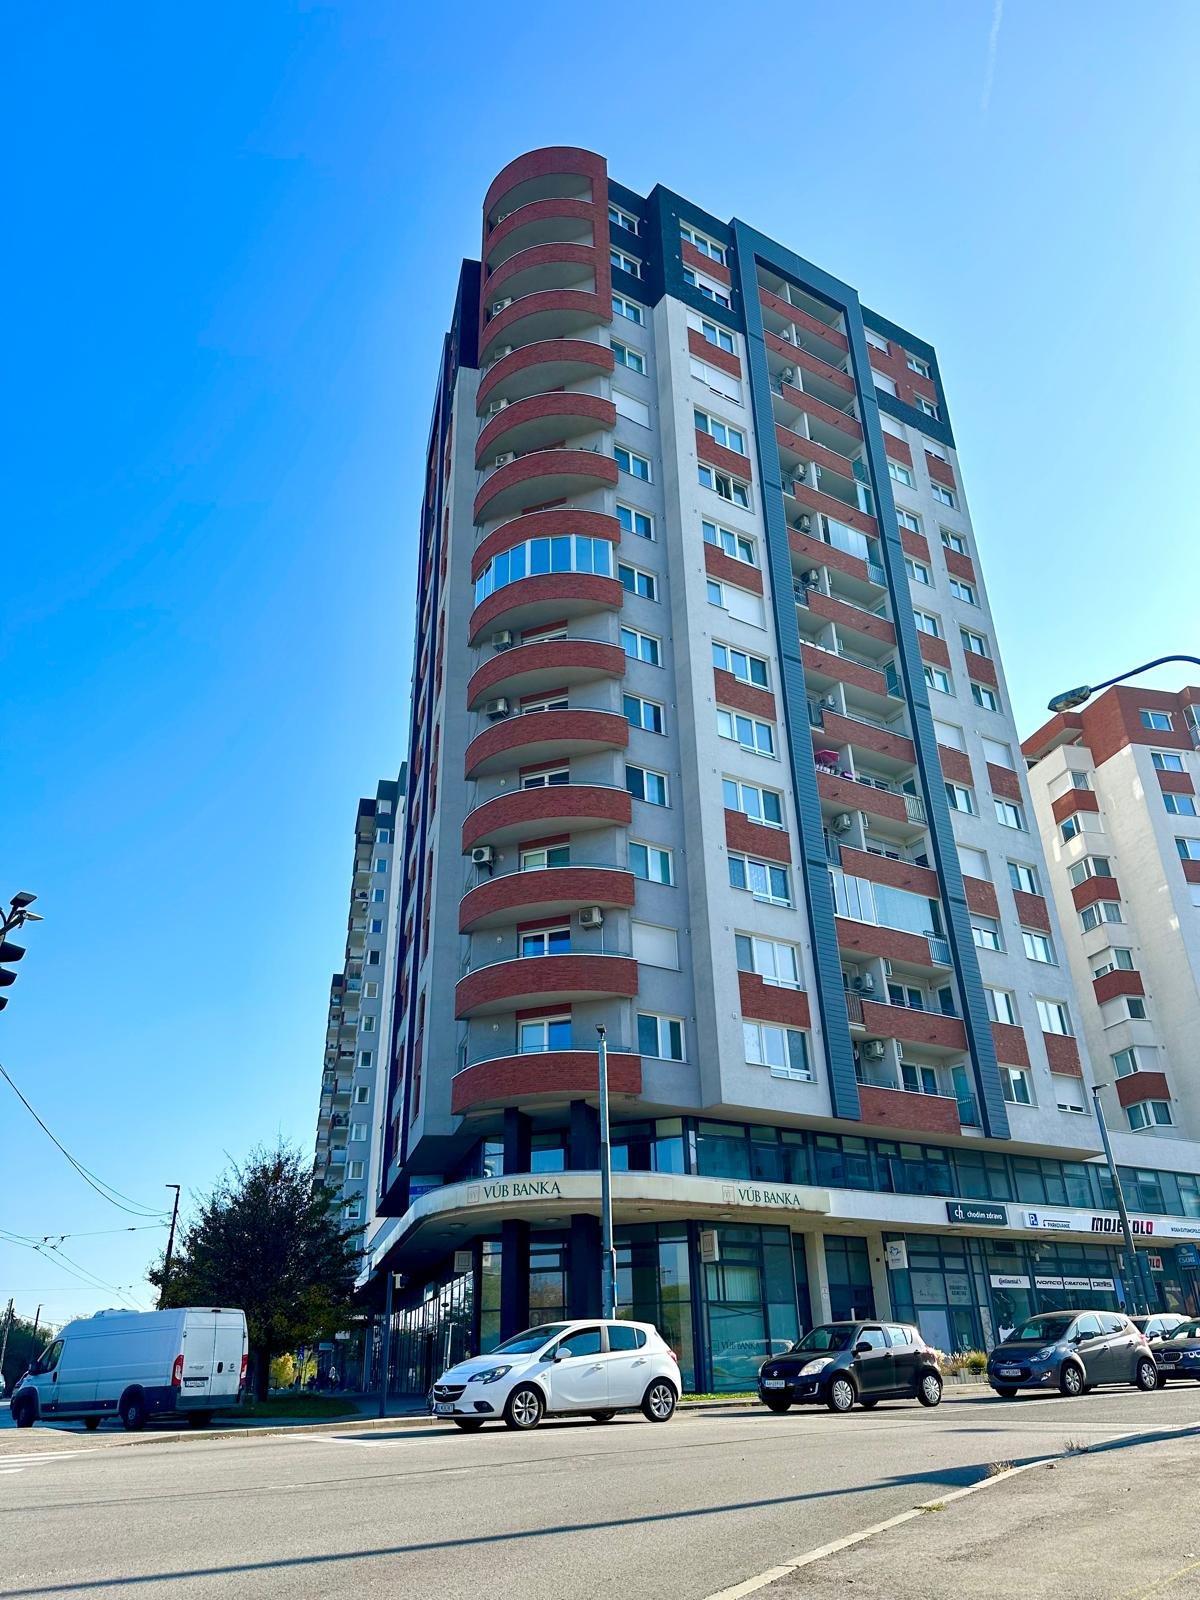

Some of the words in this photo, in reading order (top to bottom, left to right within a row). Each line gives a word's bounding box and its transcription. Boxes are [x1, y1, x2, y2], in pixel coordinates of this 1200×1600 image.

[483, 1181, 509, 1198] VÚB
[513, 1181, 561, 1196] BANKA
[738, 1186, 761, 1203] VÚB
[763, 1190, 800, 1206] BANKA
[1091, 1217, 1153, 1234] MOJEOLO
